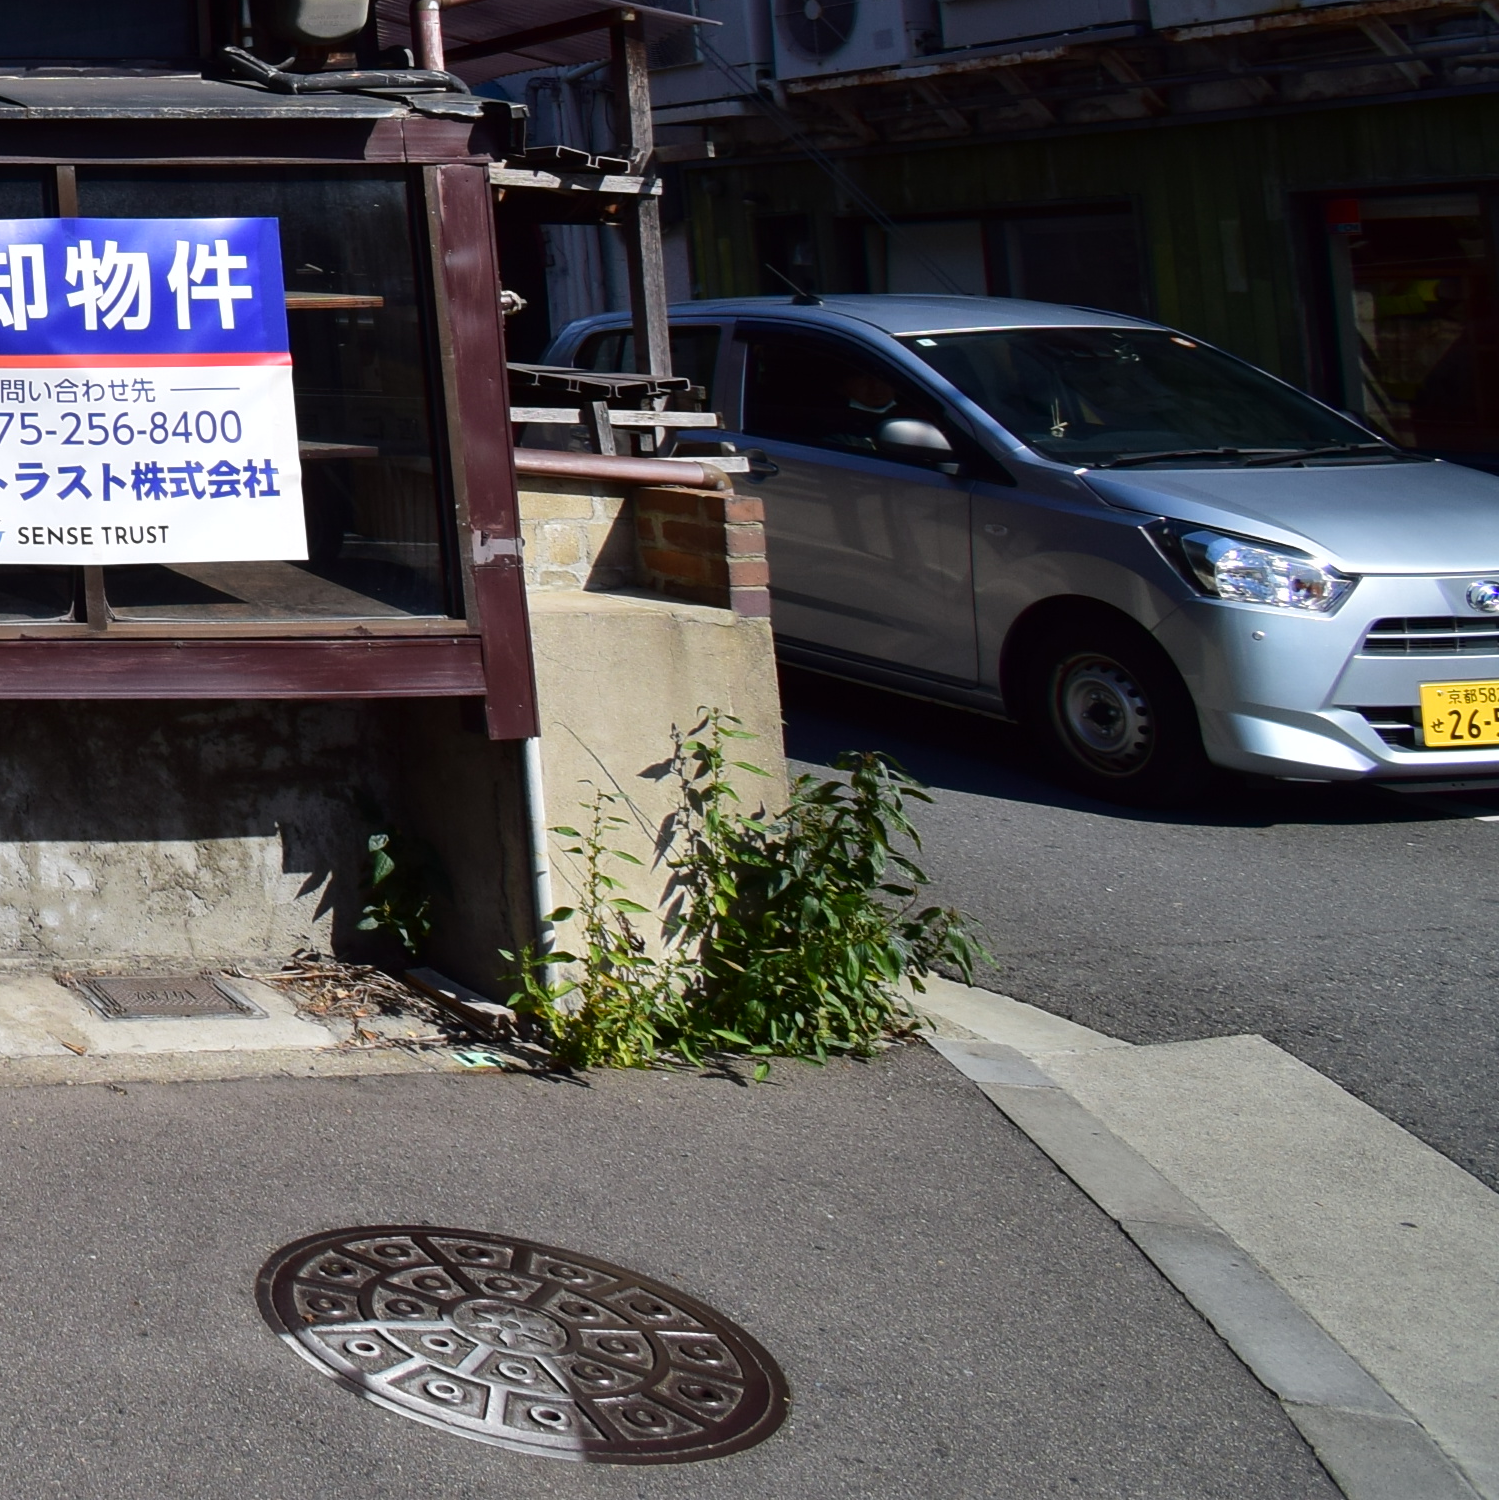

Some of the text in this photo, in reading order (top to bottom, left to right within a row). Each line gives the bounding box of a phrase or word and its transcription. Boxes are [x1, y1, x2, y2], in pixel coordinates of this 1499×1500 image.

[17, 524, 170, 546] SENSE TRUST
[1447, 689, 1477, 704] 京都
[1429, 717, 1445, 734] せ
